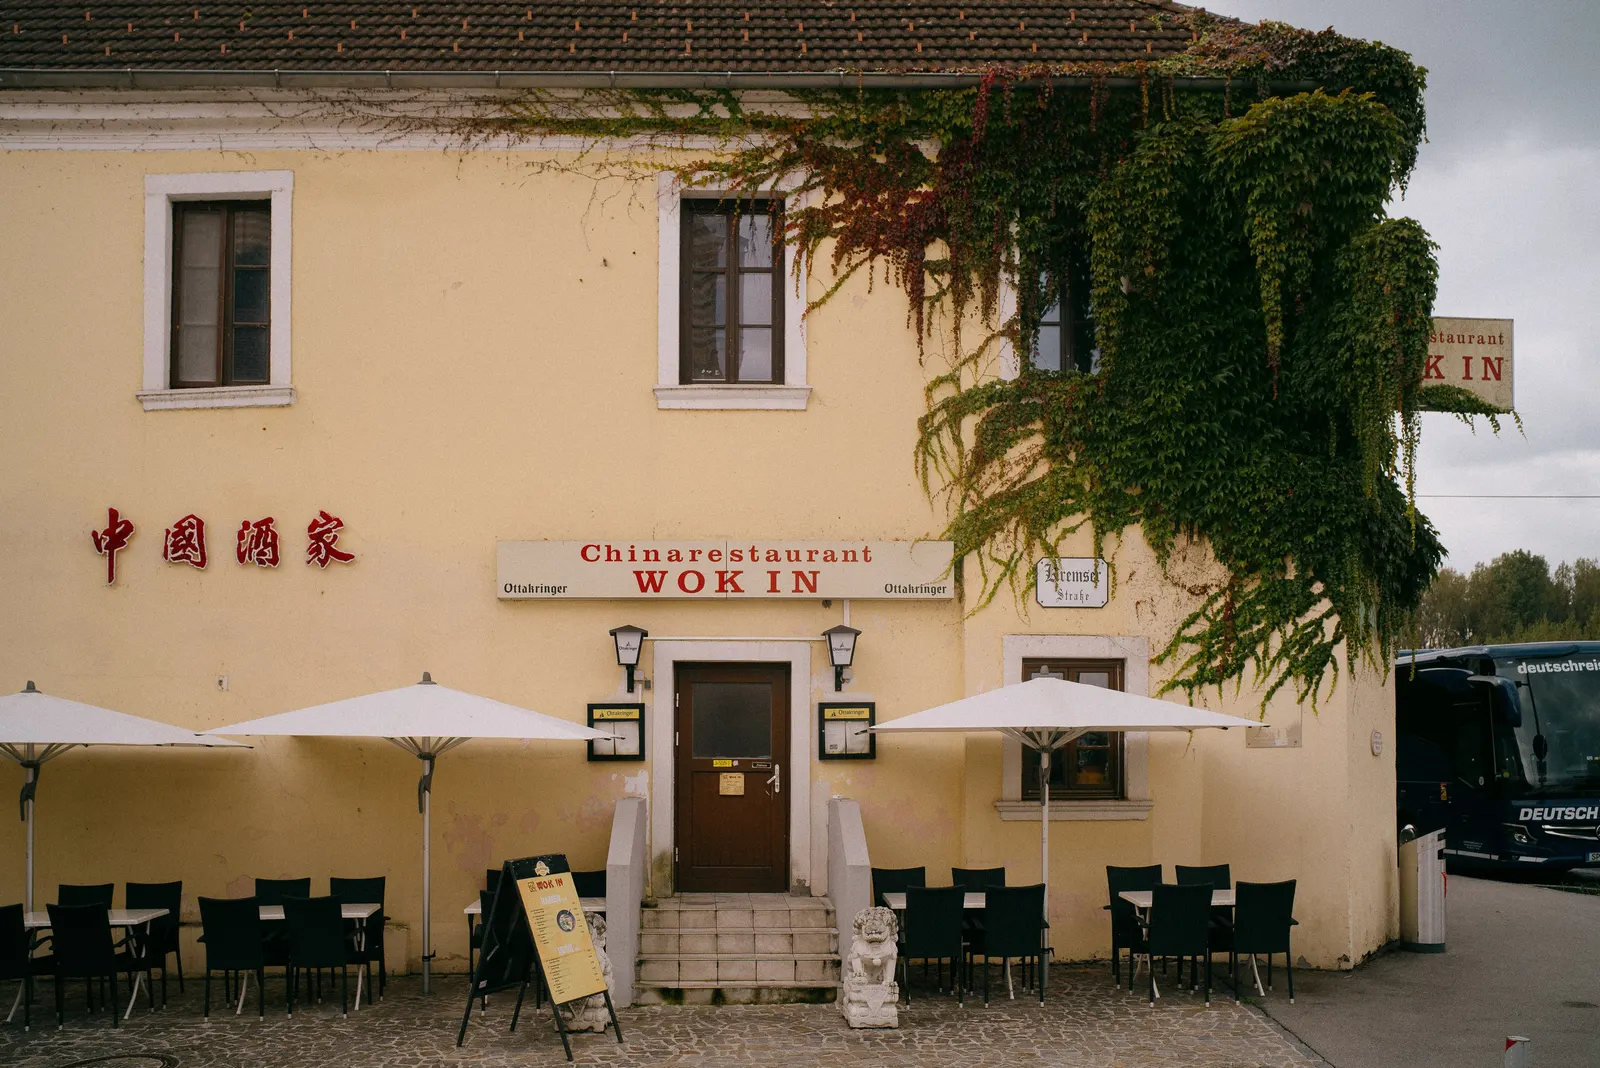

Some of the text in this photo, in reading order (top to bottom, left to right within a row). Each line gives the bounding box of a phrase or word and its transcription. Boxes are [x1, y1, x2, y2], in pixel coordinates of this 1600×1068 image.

[1462, 356, 1504, 381] IN
[91, 507, 355, 584] 中國酒家
[580, 544, 873, 562] Chinarestaurant
[504, 583, 568, 596] Ottakringer
[633, 570, 821, 593] WOK IN
[884, 583, 947, 596] Ottakringer
[1519, 807, 1599, 821] DEUTSCH
[536, 879, 555, 891] WOK
[555, 878, 564, 887] IN
